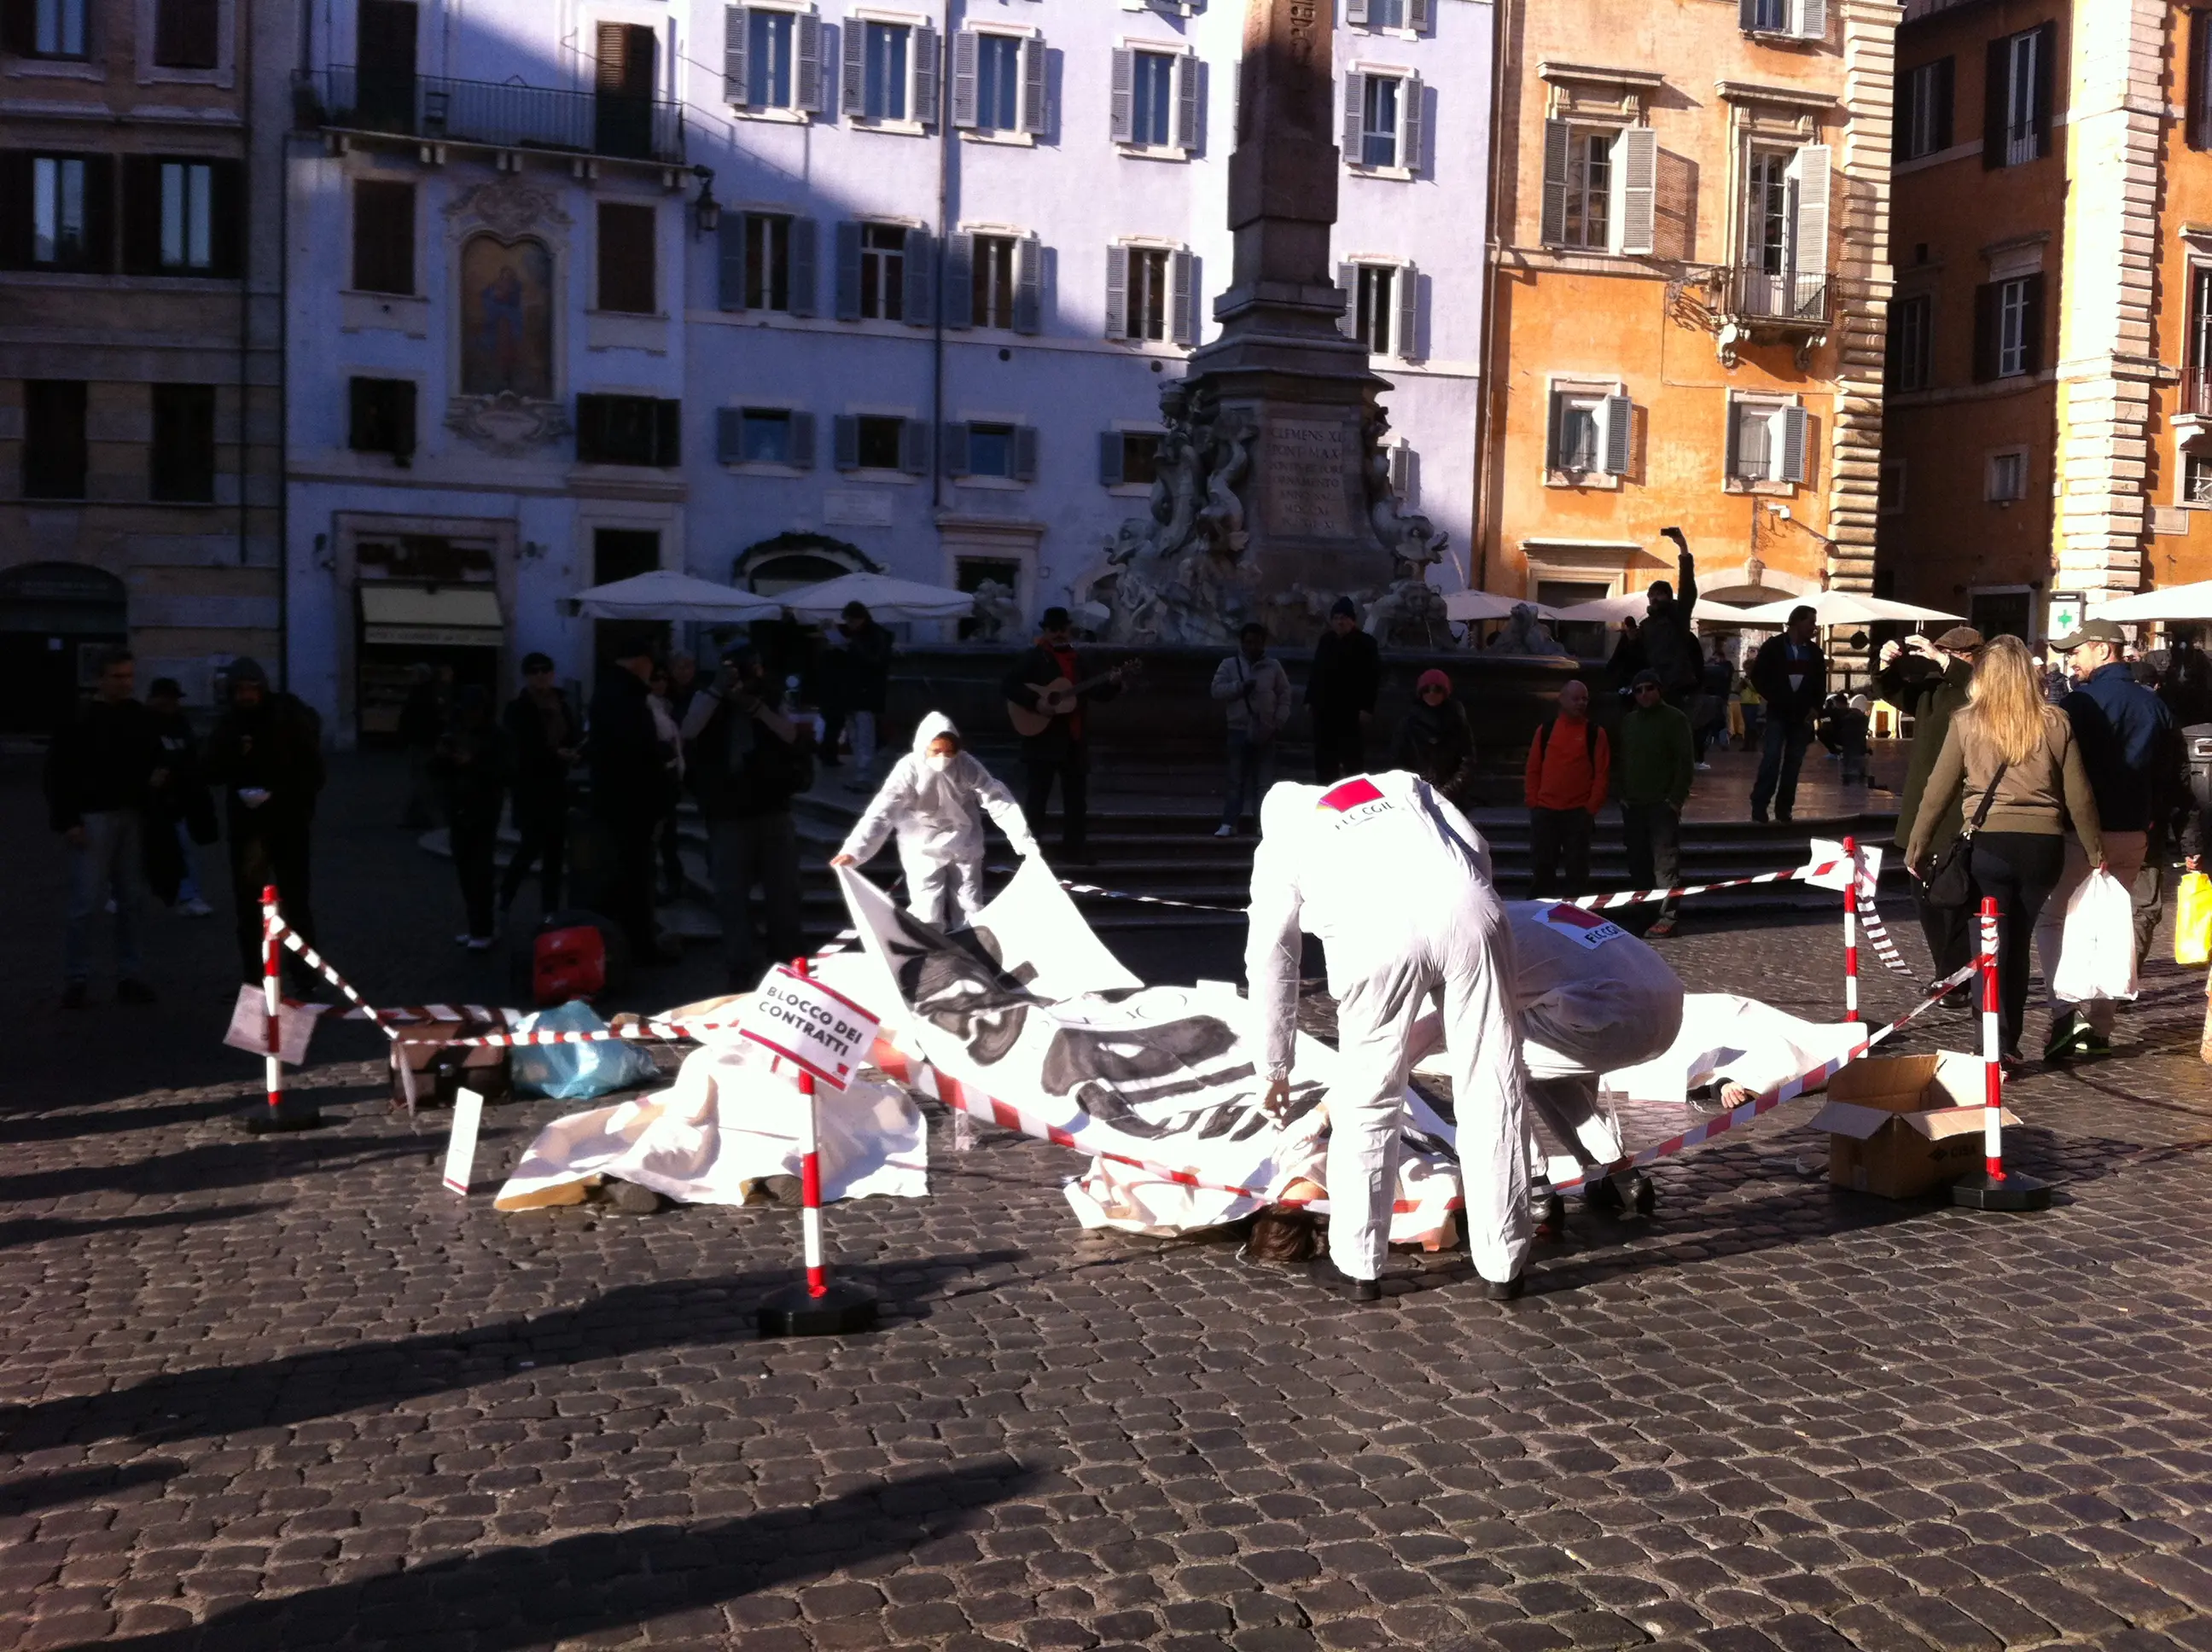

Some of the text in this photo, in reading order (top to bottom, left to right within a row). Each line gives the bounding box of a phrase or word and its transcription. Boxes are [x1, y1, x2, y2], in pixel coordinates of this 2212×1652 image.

[1270, 428, 1324, 442] CLEMENS
[1361, 801, 1396, 816] CGIL
[759, 1001, 850, 1057] CONTRATTI
[766, 986, 864, 1045] BLOCCO DEI
